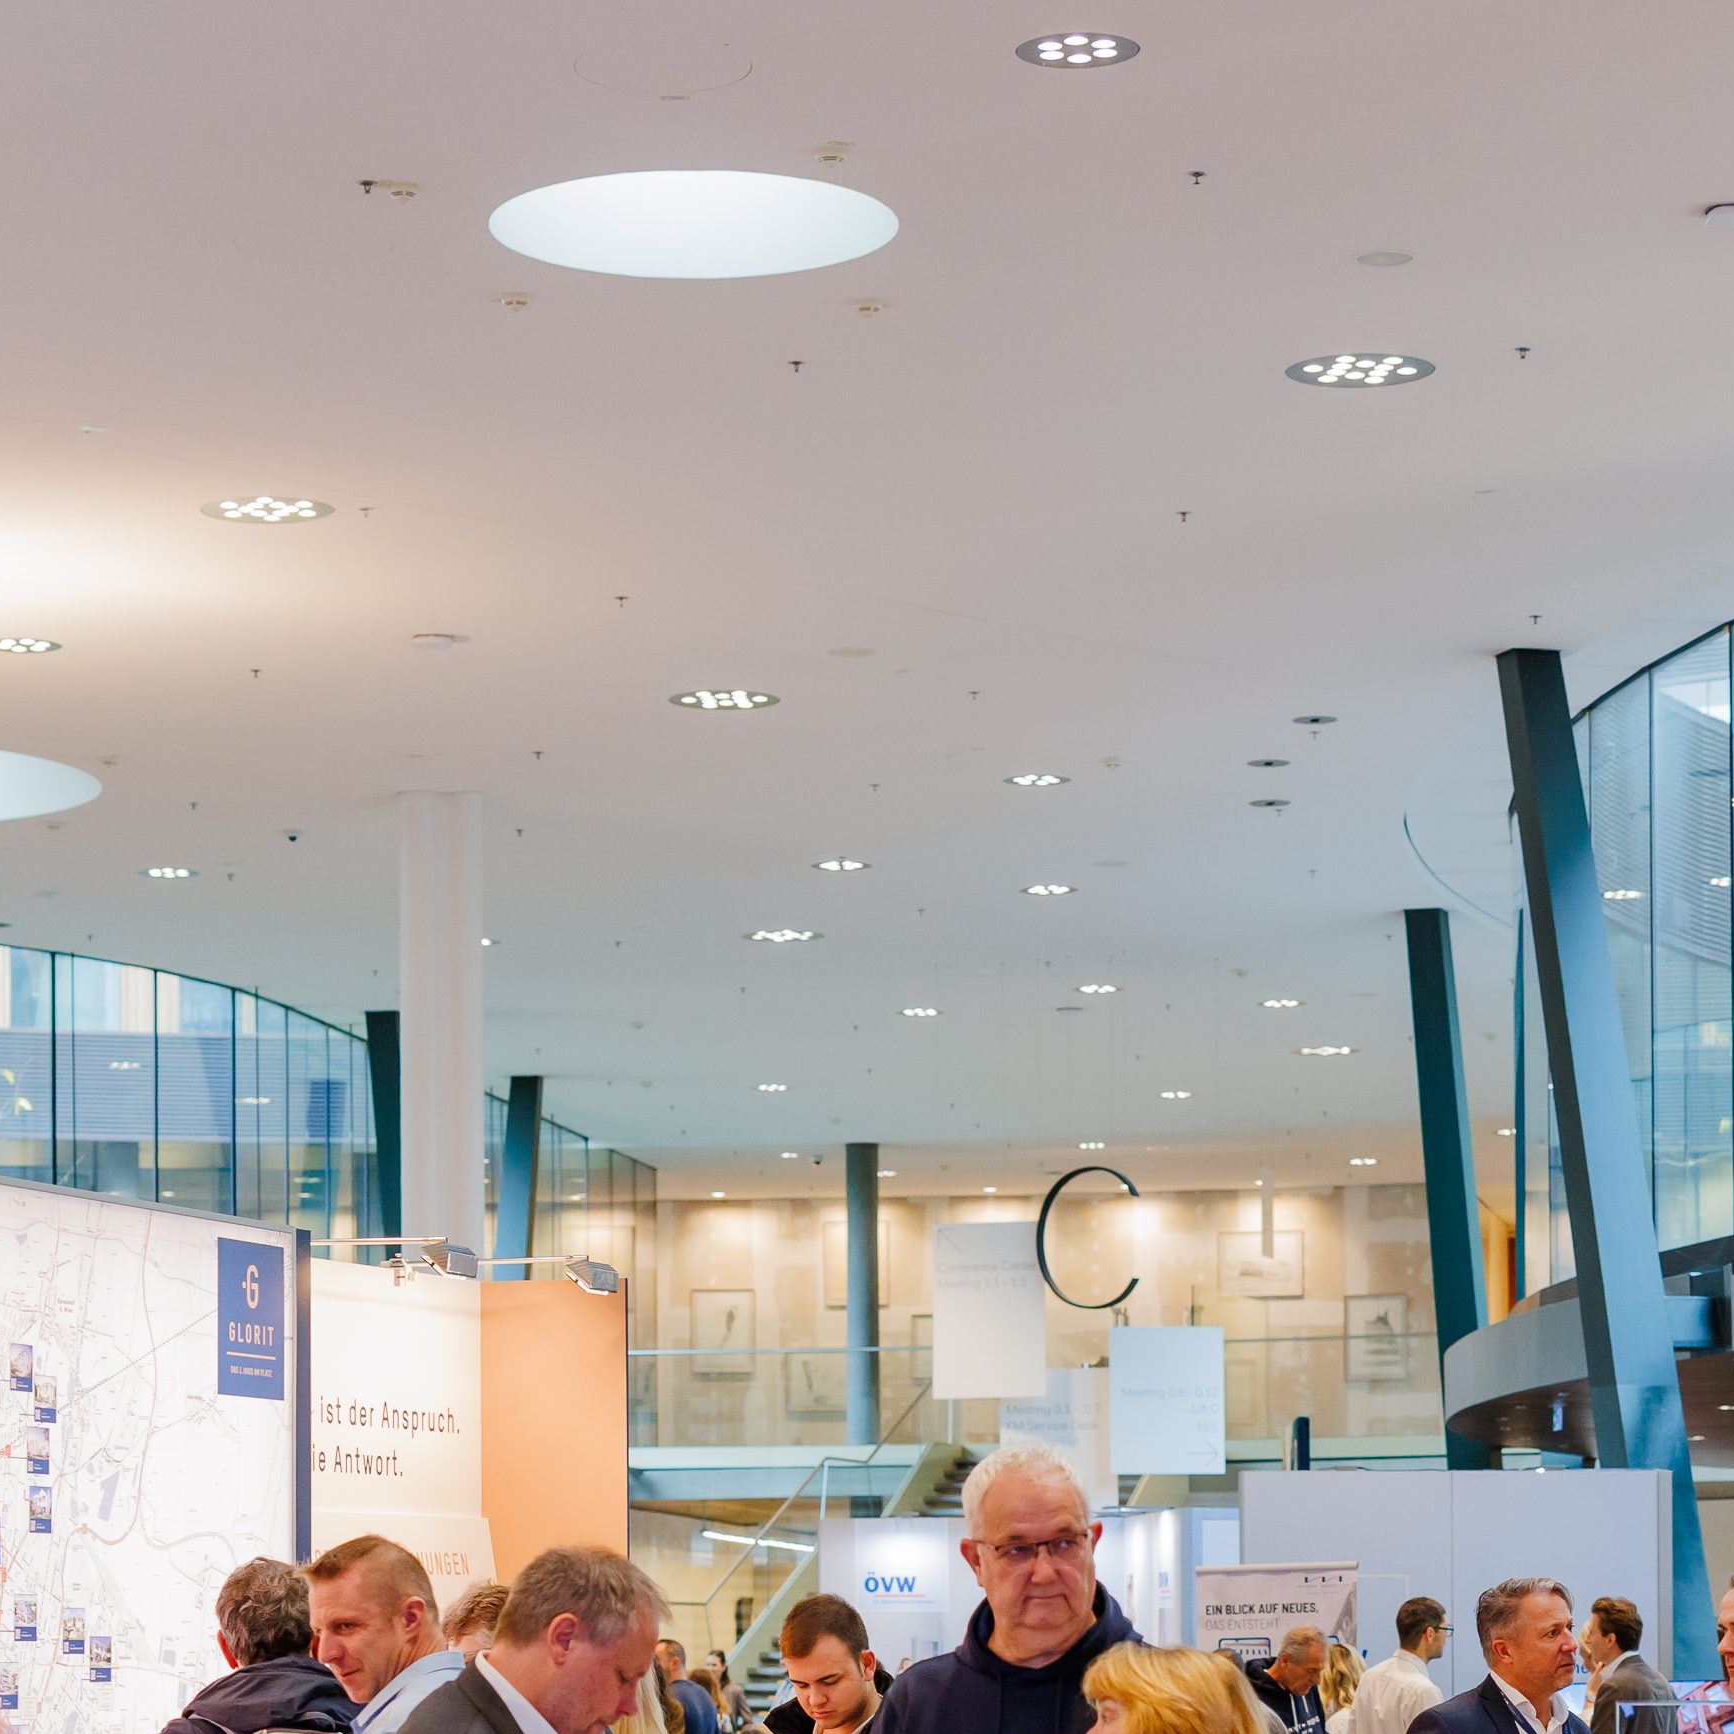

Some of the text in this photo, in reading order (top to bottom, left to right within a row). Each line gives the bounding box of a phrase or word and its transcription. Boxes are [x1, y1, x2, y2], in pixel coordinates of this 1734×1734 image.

[1036, 1166, 1139, 1310] C
[937, 1261, 999, 1274] Conference
[937, 1278, 981, 1291] Meeting
[228, 1321, 275, 1347] GLORIT
[230, 1365, 239, 1374] DAS
[260, 1369, 273, 1378] PLATZ
[1121, 1387, 1166, 1400] Meeting
[1194, 1387, 1218, 1397] 0.12
[1005, 1403, 1051, 1417] Meeting
[320, 1395, 460, 1439] ist der Anspruch.
[1027, 1420, 1068, 1431] Service
[1071, 1420, 1098, 1431] Desk
[333, 1445, 403, 1477] Antwort.
[1205, 1602, 1319, 1616] EIN BLICK AUF NEUES,
[1205, 1618, 1280, 1631] DAS ENTSTEHT
